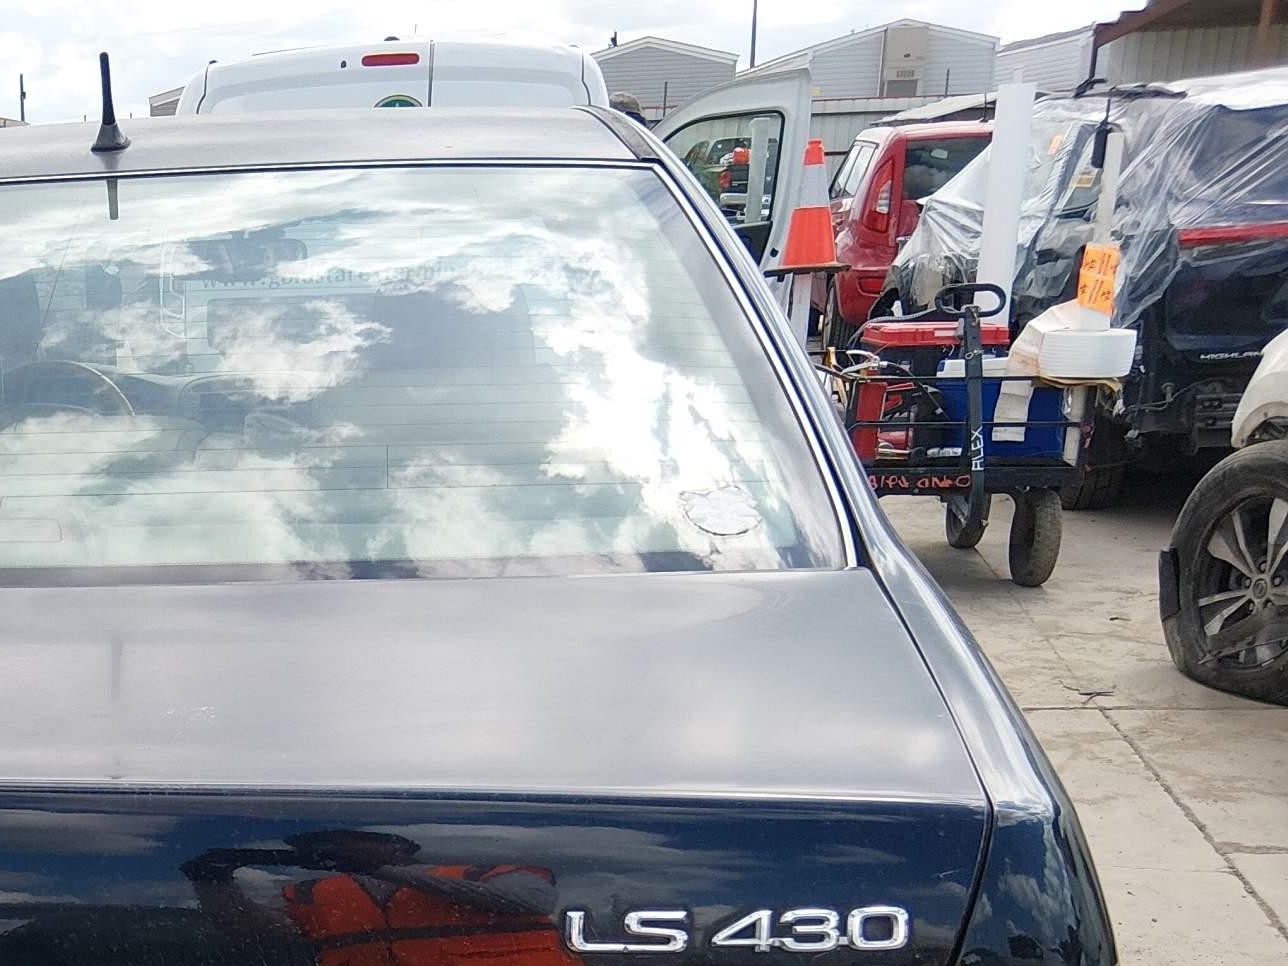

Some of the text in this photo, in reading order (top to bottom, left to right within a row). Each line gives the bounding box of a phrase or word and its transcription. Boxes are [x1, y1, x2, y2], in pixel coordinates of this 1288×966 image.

[971, 425, 984, 471] ALEX
[565, 905, 909, 953] LS 430
